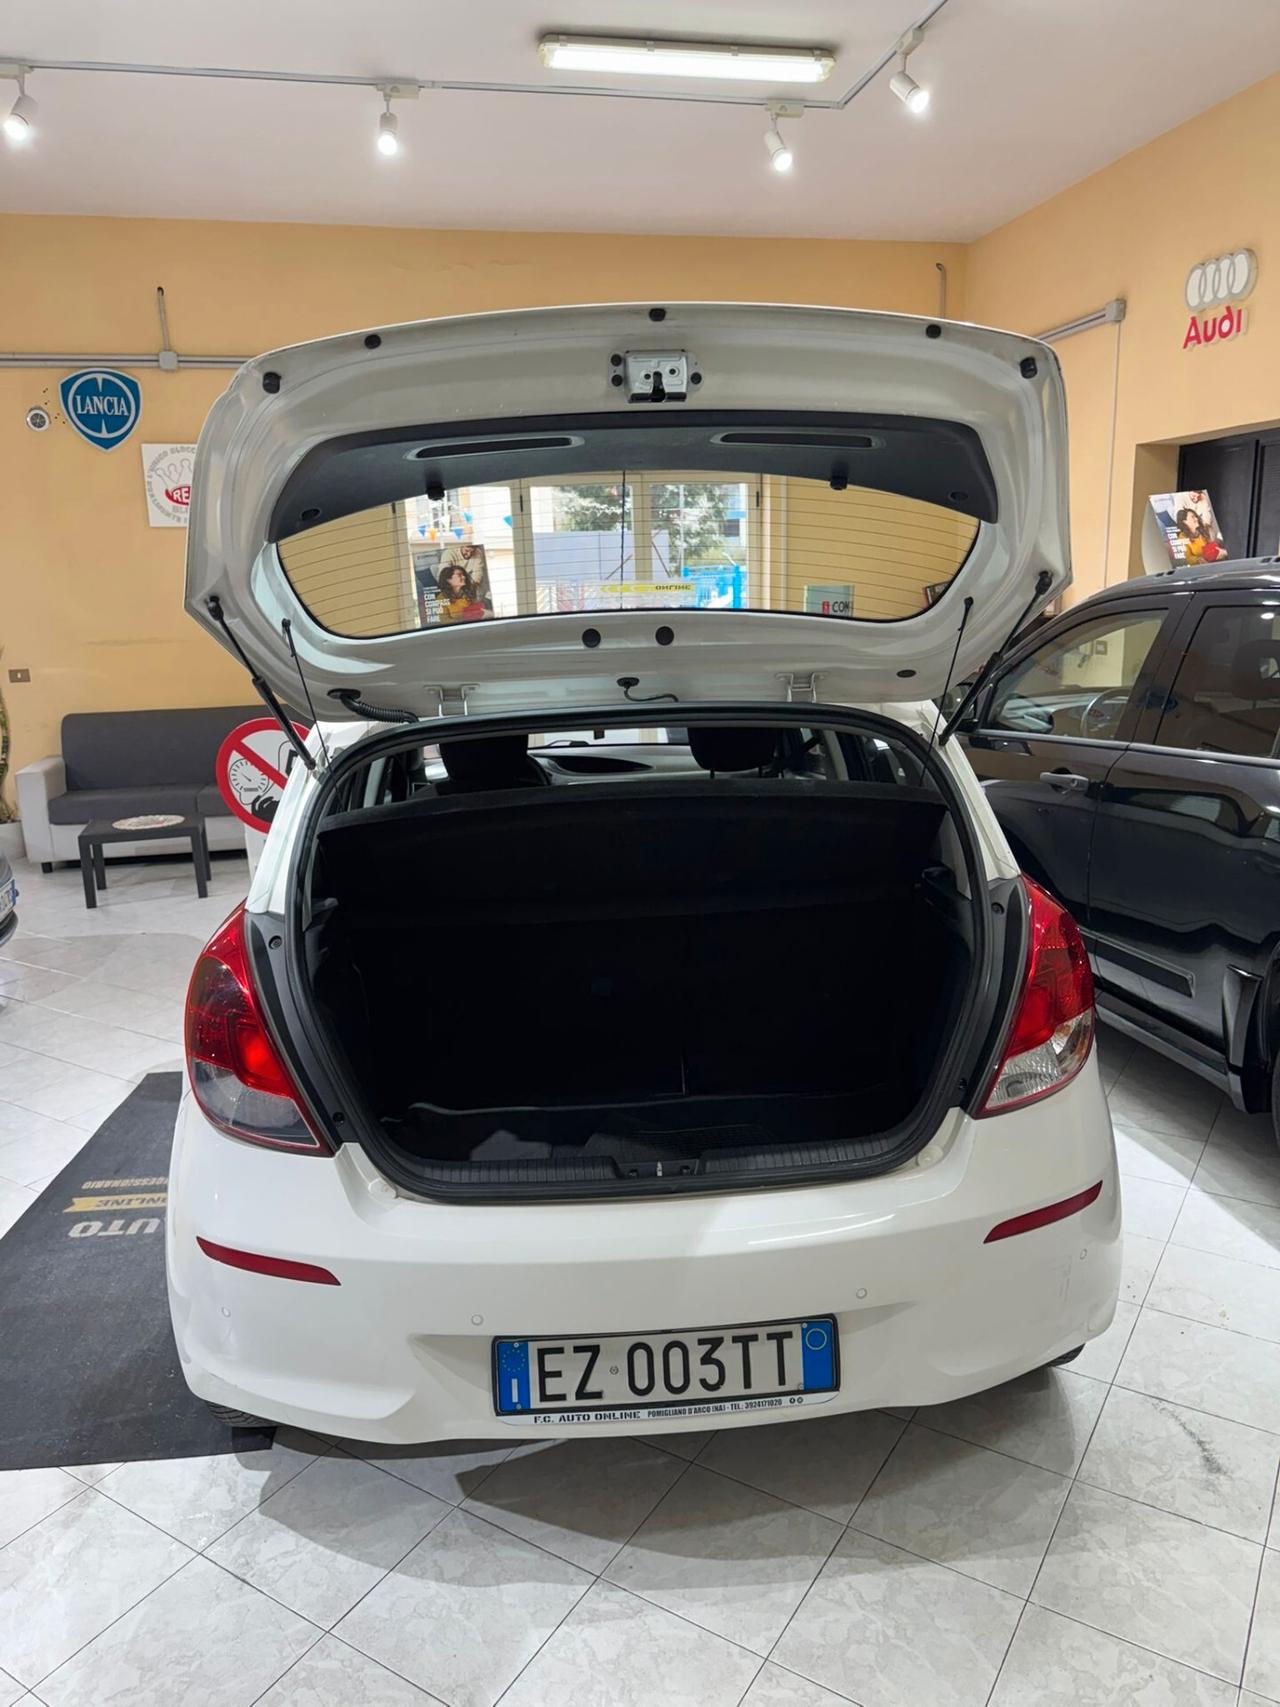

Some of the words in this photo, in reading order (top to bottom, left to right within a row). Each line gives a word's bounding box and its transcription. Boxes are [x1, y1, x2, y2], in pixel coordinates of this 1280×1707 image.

[1183, 305, 1242, 349] Audi
[75, 395, 129, 416] LANCIA
[172, 487, 190, 503] RE
[68, 1218, 161, 1238] UTO
[537, 1344, 604, 1403] EZ
[626, 1330, 794, 1398] 003TT
[558, 1413, 591, 1423] AUTO
[594, 1411, 641, 1421] ONLINE
[647, 1408, 687, 1418] POMIGLIANO
[688, 1406, 711, 1416] D'ARCO
